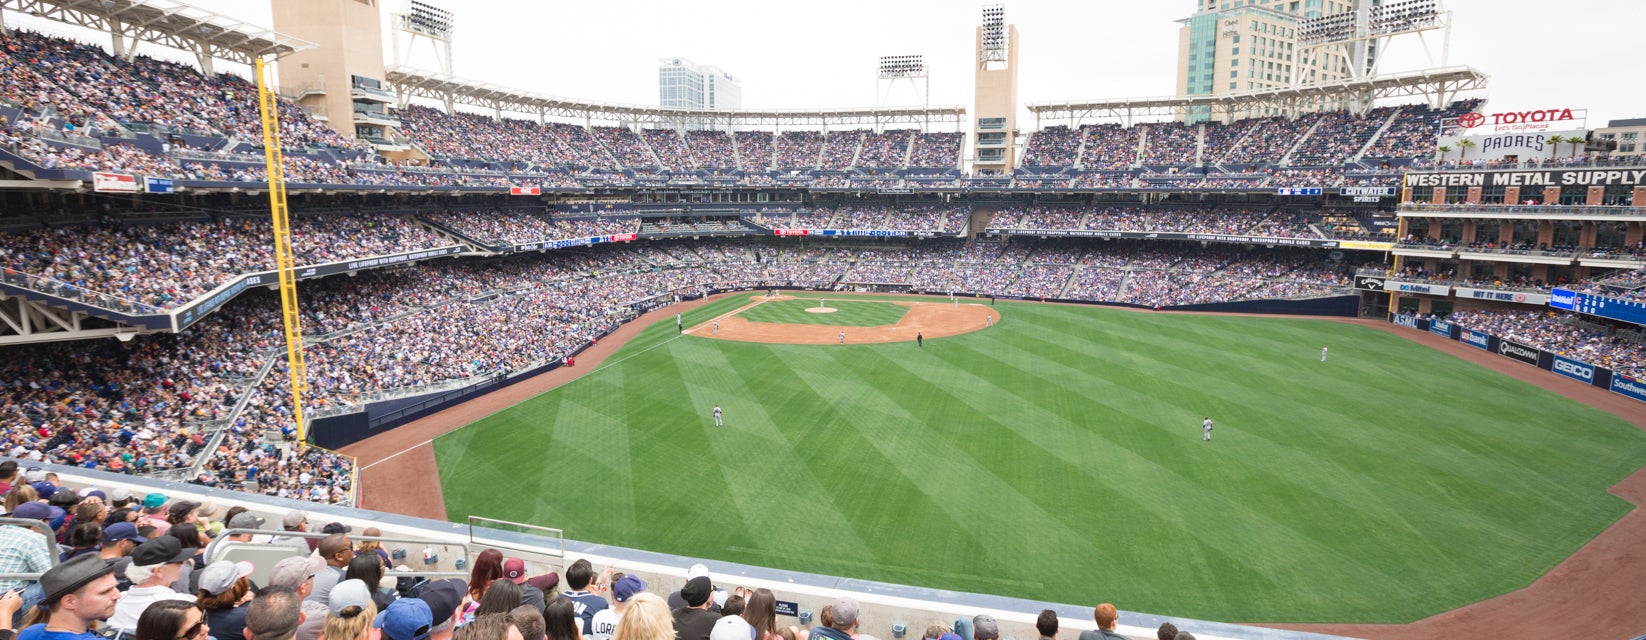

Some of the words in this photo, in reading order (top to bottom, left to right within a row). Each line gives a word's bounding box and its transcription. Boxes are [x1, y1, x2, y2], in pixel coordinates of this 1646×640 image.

[1492, 108, 1574, 124] TOYOTA
[1482, 134, 1545, 153] PADRES
[1406, 173, 1485, 186] WESTERN
[1492, 172, 1556, 186] METAL
[1562, 170, 1646, 185] SUPPLY
[1346, 187, 1389, 196] CUTWATER
[1361, 277, 1384, 286] Callaway
[1410, 285, 1430, 293] Mitel
[1393, 314, 1418, 328] ASML
[1500, 342, 1537, 360] QUALCOMM
[1554, 360, 1592, 379] GEICO
